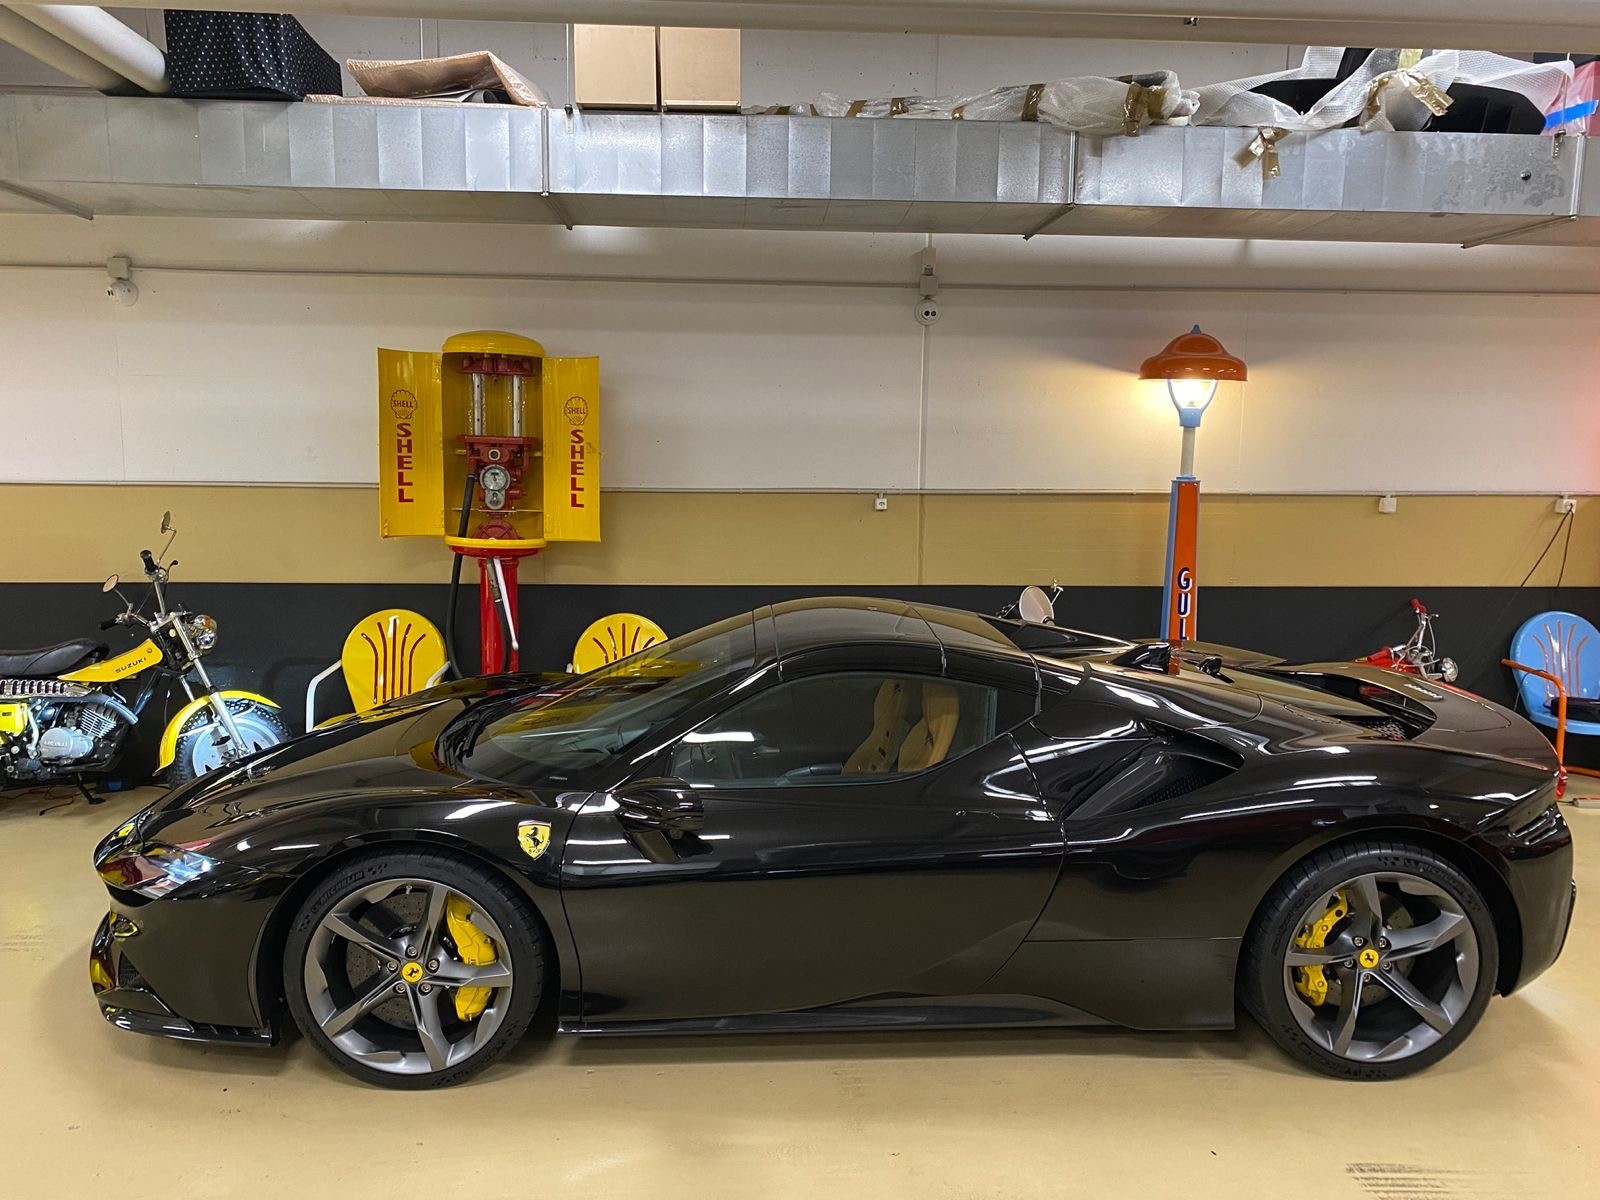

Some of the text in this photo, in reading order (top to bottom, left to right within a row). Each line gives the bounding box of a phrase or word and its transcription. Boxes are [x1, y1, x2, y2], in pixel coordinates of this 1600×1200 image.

[393, 400, 413, 408] SHELL
[566, 407, 586, 415] SHELL
[396, 422, 414, 503] SHELL
[570, 429, 585, 508] SHELL
[115, 657, 147, 673] SUZUKI
